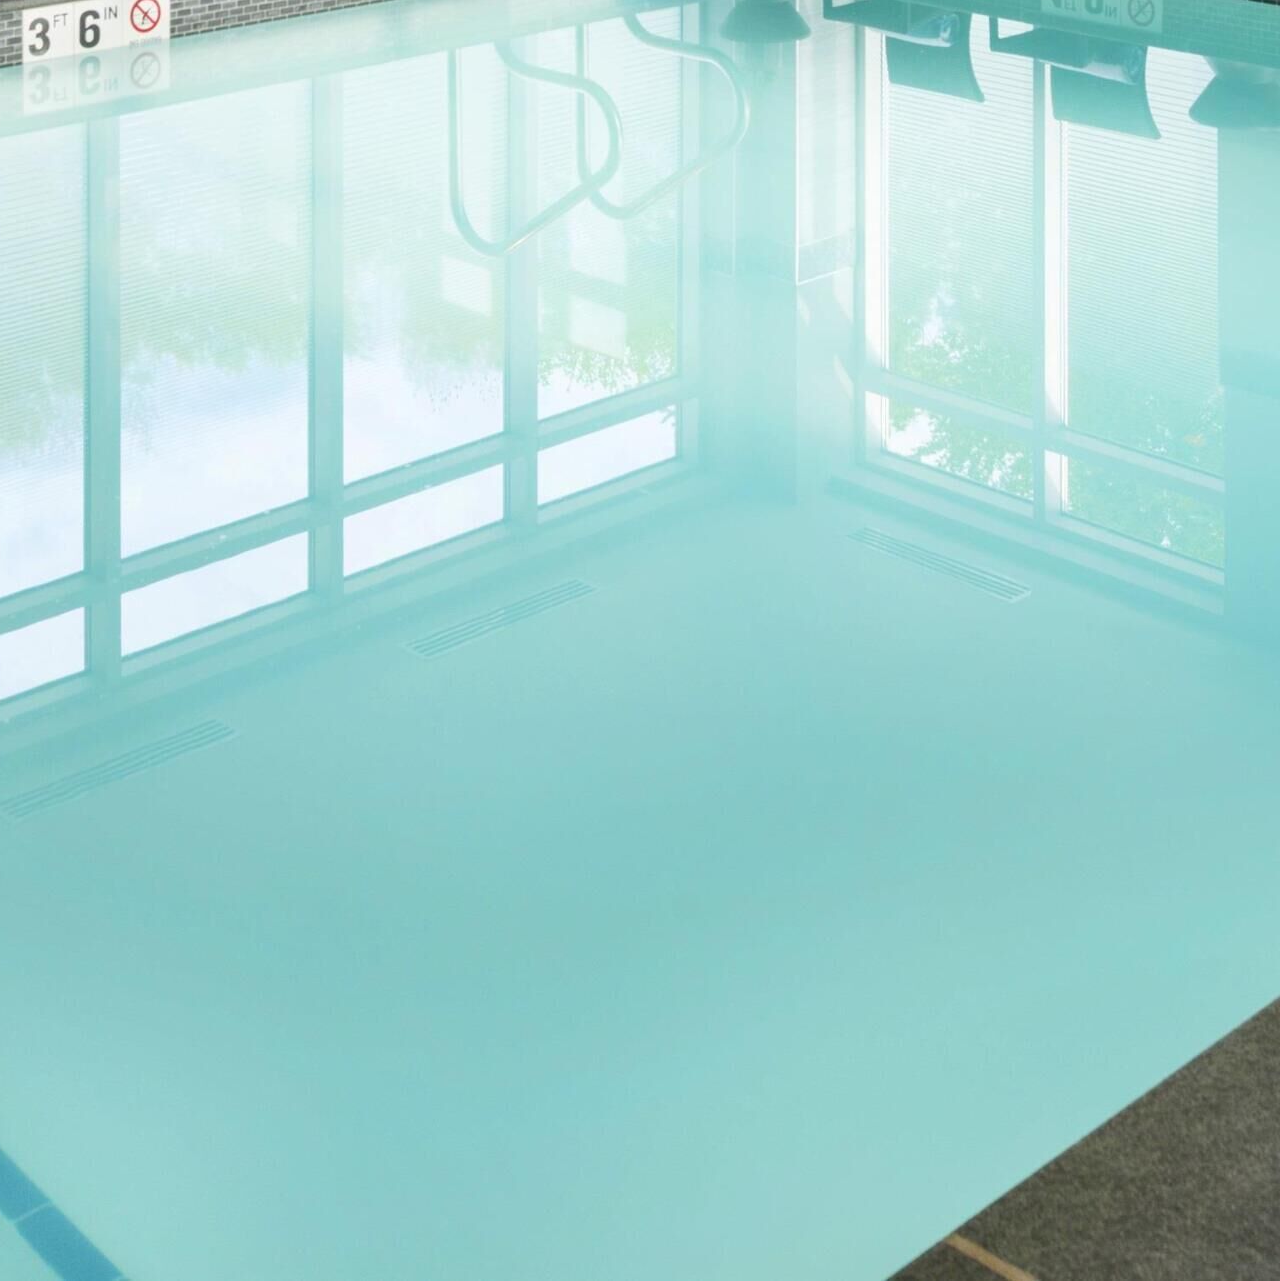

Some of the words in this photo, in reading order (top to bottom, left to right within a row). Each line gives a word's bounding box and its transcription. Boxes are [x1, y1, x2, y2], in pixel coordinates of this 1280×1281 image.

[28, 17, 51, 56] 3
[53, 13, 68, 28] FT
[79, 10, 101, 48] 6
[104, 5, 118, 20] IN
